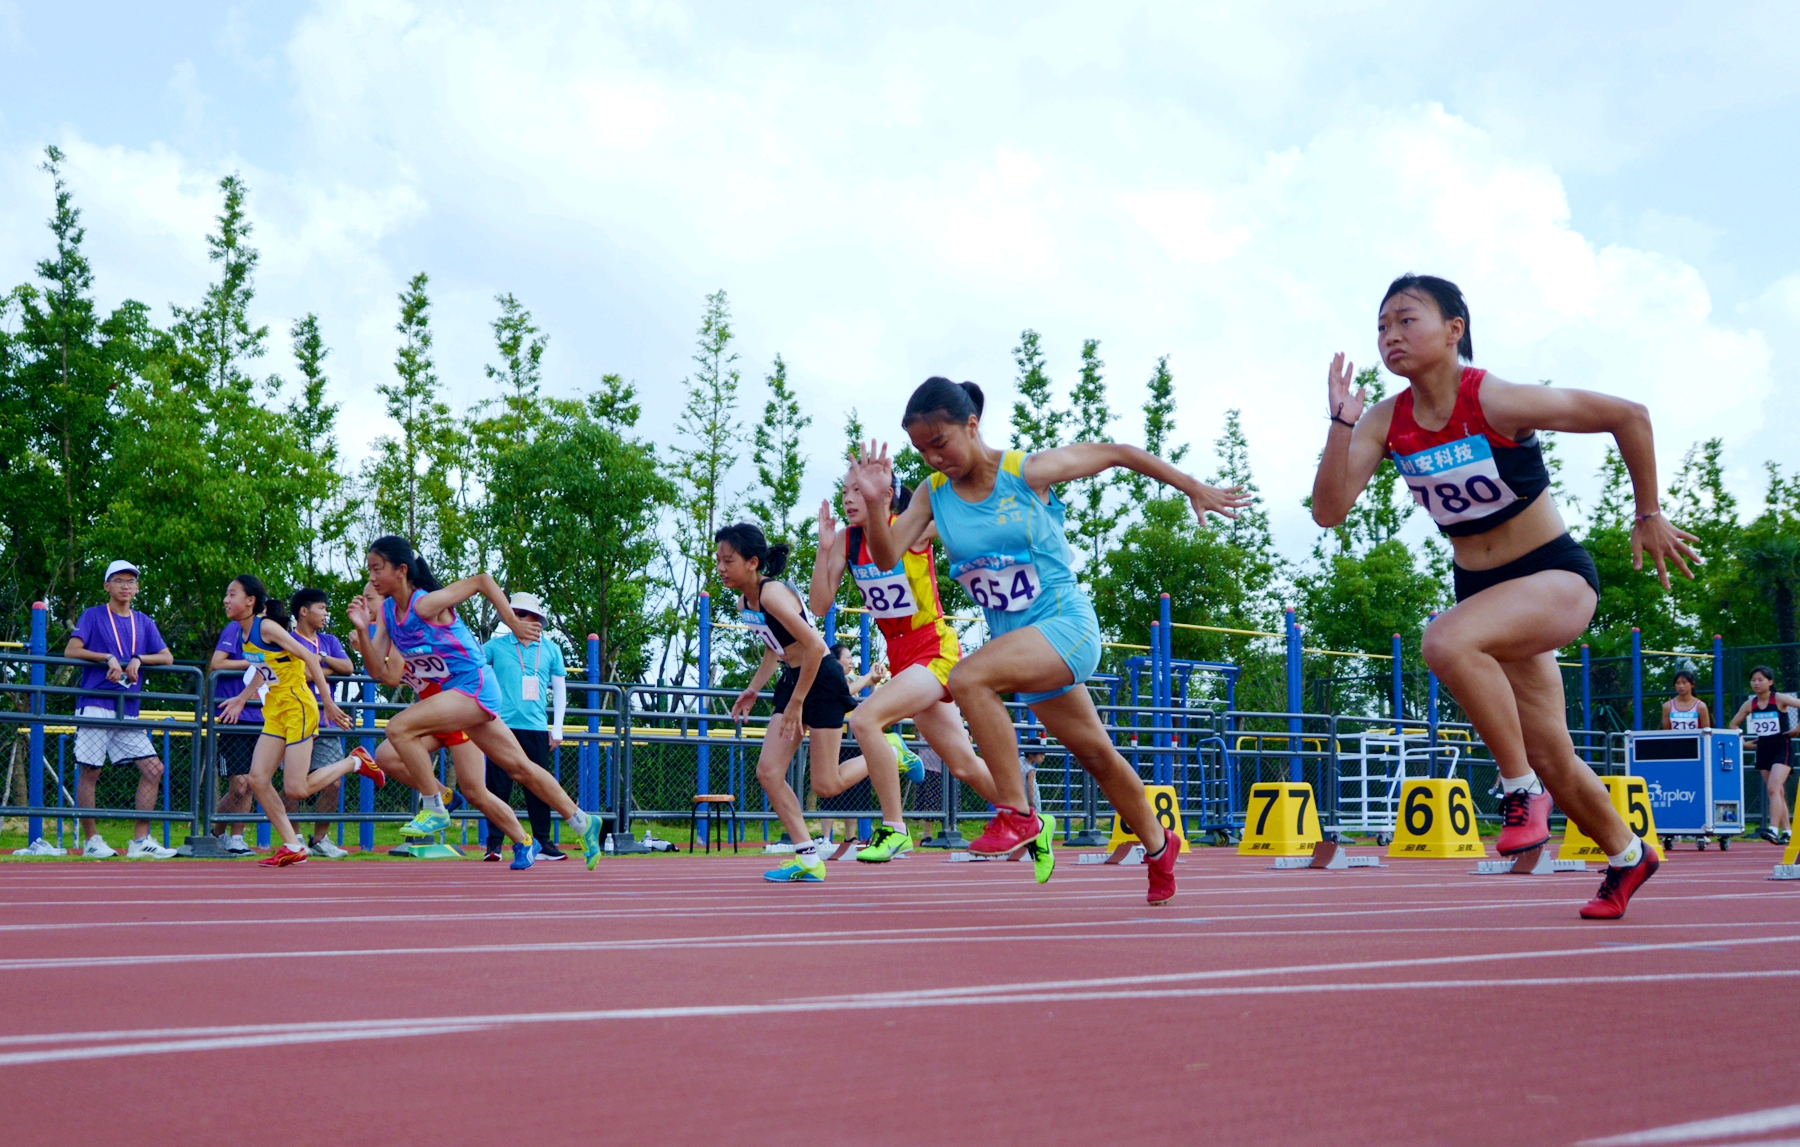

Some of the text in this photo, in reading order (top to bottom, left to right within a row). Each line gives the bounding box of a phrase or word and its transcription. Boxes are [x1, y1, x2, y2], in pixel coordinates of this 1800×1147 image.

[1409, 474, 1502, 513] 780
[970, 569, 1035, 611] 654
[1754, 721, 1778, 733] 292
[1155, 792, 1176, 832] 8
[1253, 790, 1280, 836] 7
[1288, 790, 1311, 836] 7
[1405, 786, 1434, 836] 6
[1448, 786, 1471, 836] 6
[1627, 784, 1649, 838] 5
[1648, 789, 1697, 808] airplay
